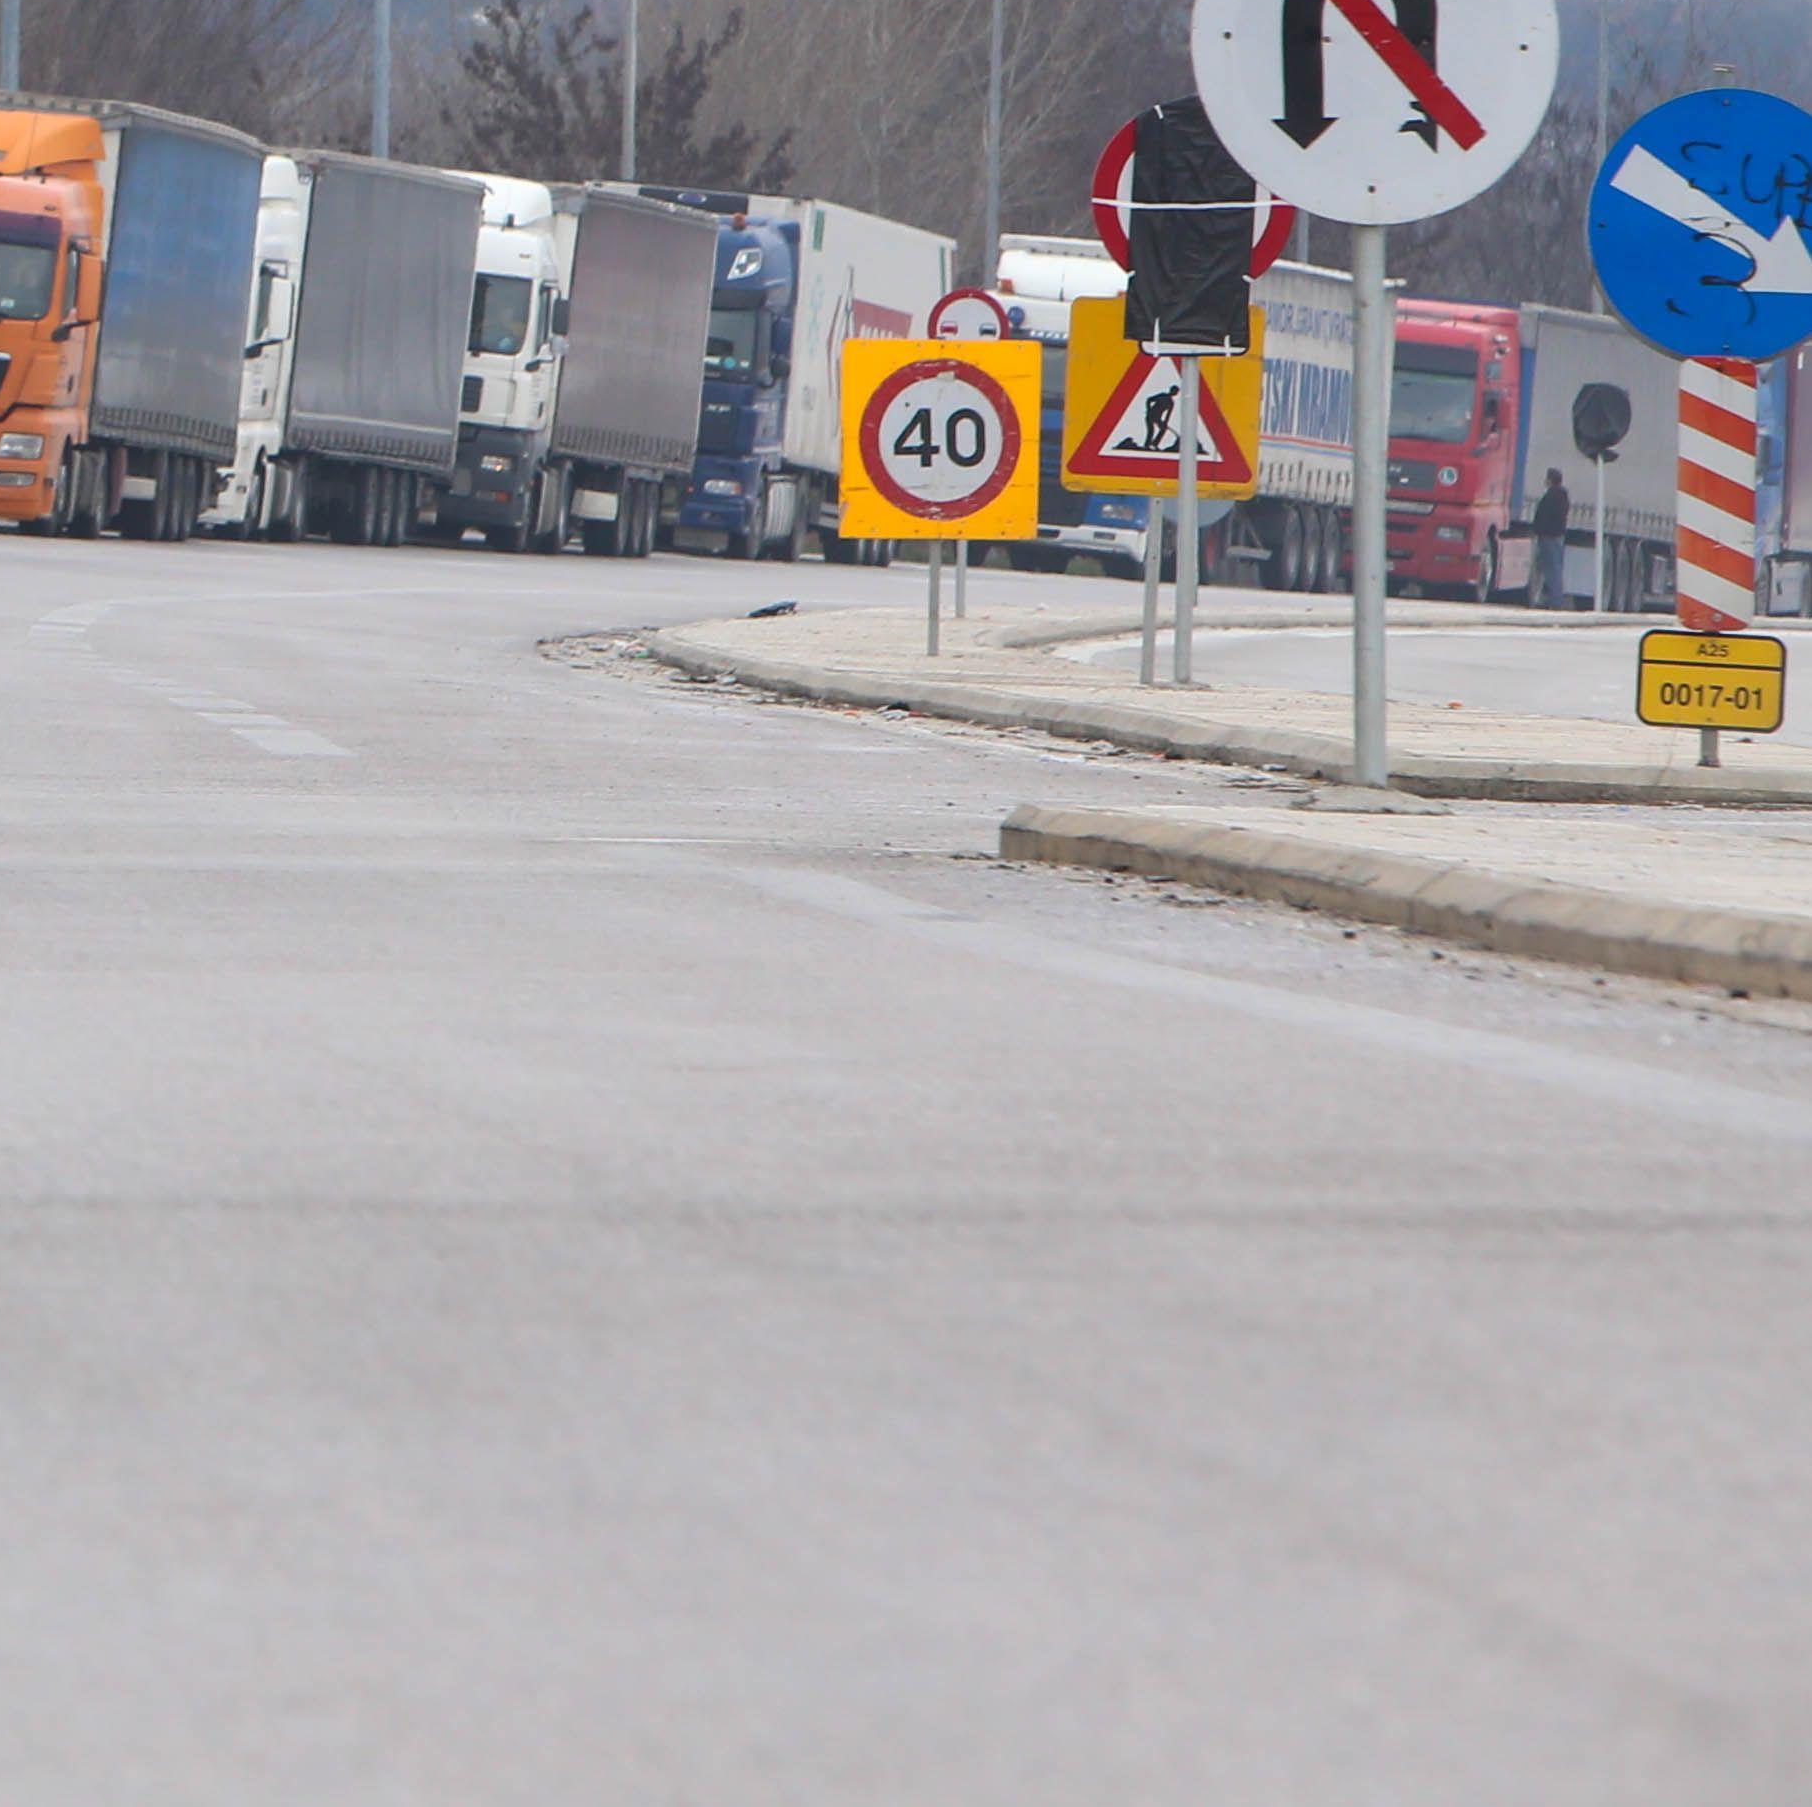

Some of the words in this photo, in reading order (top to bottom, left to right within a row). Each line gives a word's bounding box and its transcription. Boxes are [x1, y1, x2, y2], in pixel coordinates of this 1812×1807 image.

[893, 407, 986, 468] 40
[1697, 643, 1730, 658] A25
[1660, 682, 1763, 710] 0017-01
